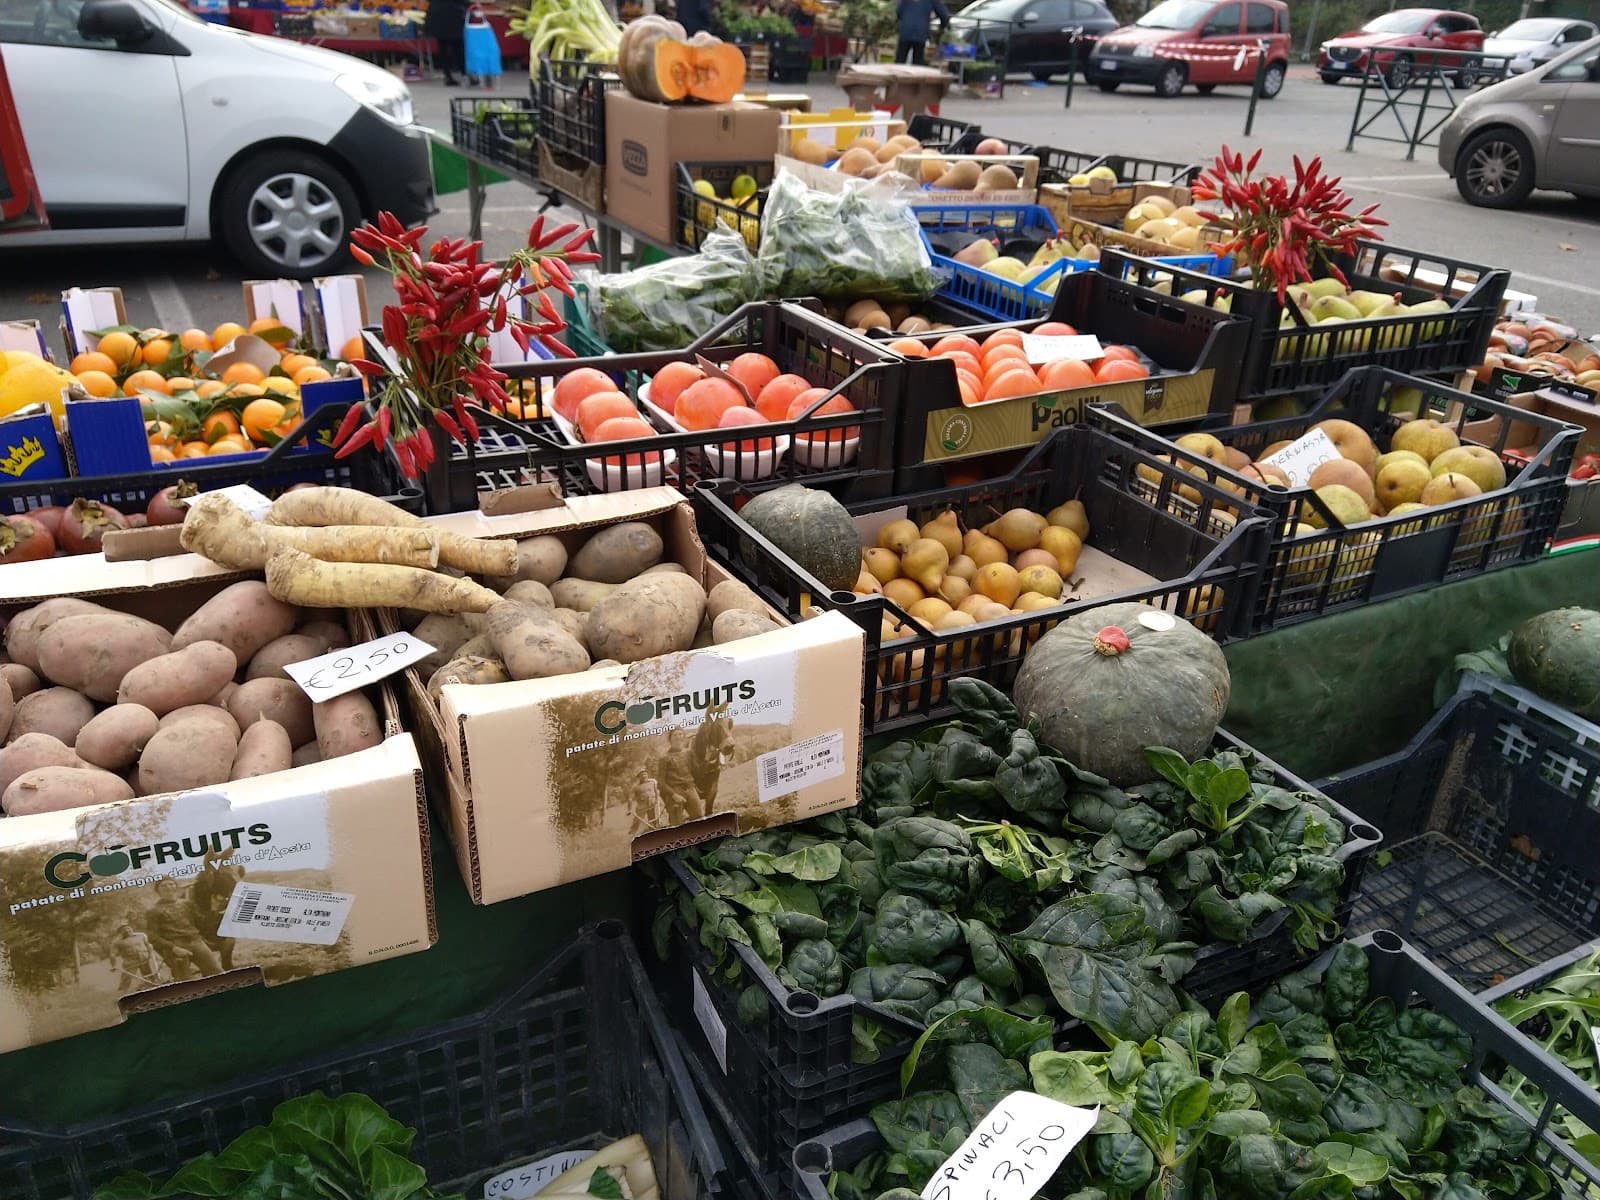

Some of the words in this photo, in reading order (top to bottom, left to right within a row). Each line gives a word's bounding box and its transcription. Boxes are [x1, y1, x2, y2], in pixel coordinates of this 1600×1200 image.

[565, 738, 606, 758] patate
[608, 733, 620, 746] di
[623, 723, 675, 742] montagna
[679, 715, 706, 729] della
[709, 706, 739, 723] Valle
[741, 698, 782, 715] d'Aosta
[594, 679, 756, 735] COFRUITS
[9, 892, 65, 916] patate
[69, 887, 86, 900] di
[90, 872, 164, 896] montagna
[167, 863, 206, 879] della
[209, 853, 250, 872] Valle
[255, 841, 312, 862] d'Aosta
[44, 823, 272, 889] COFRUITS
